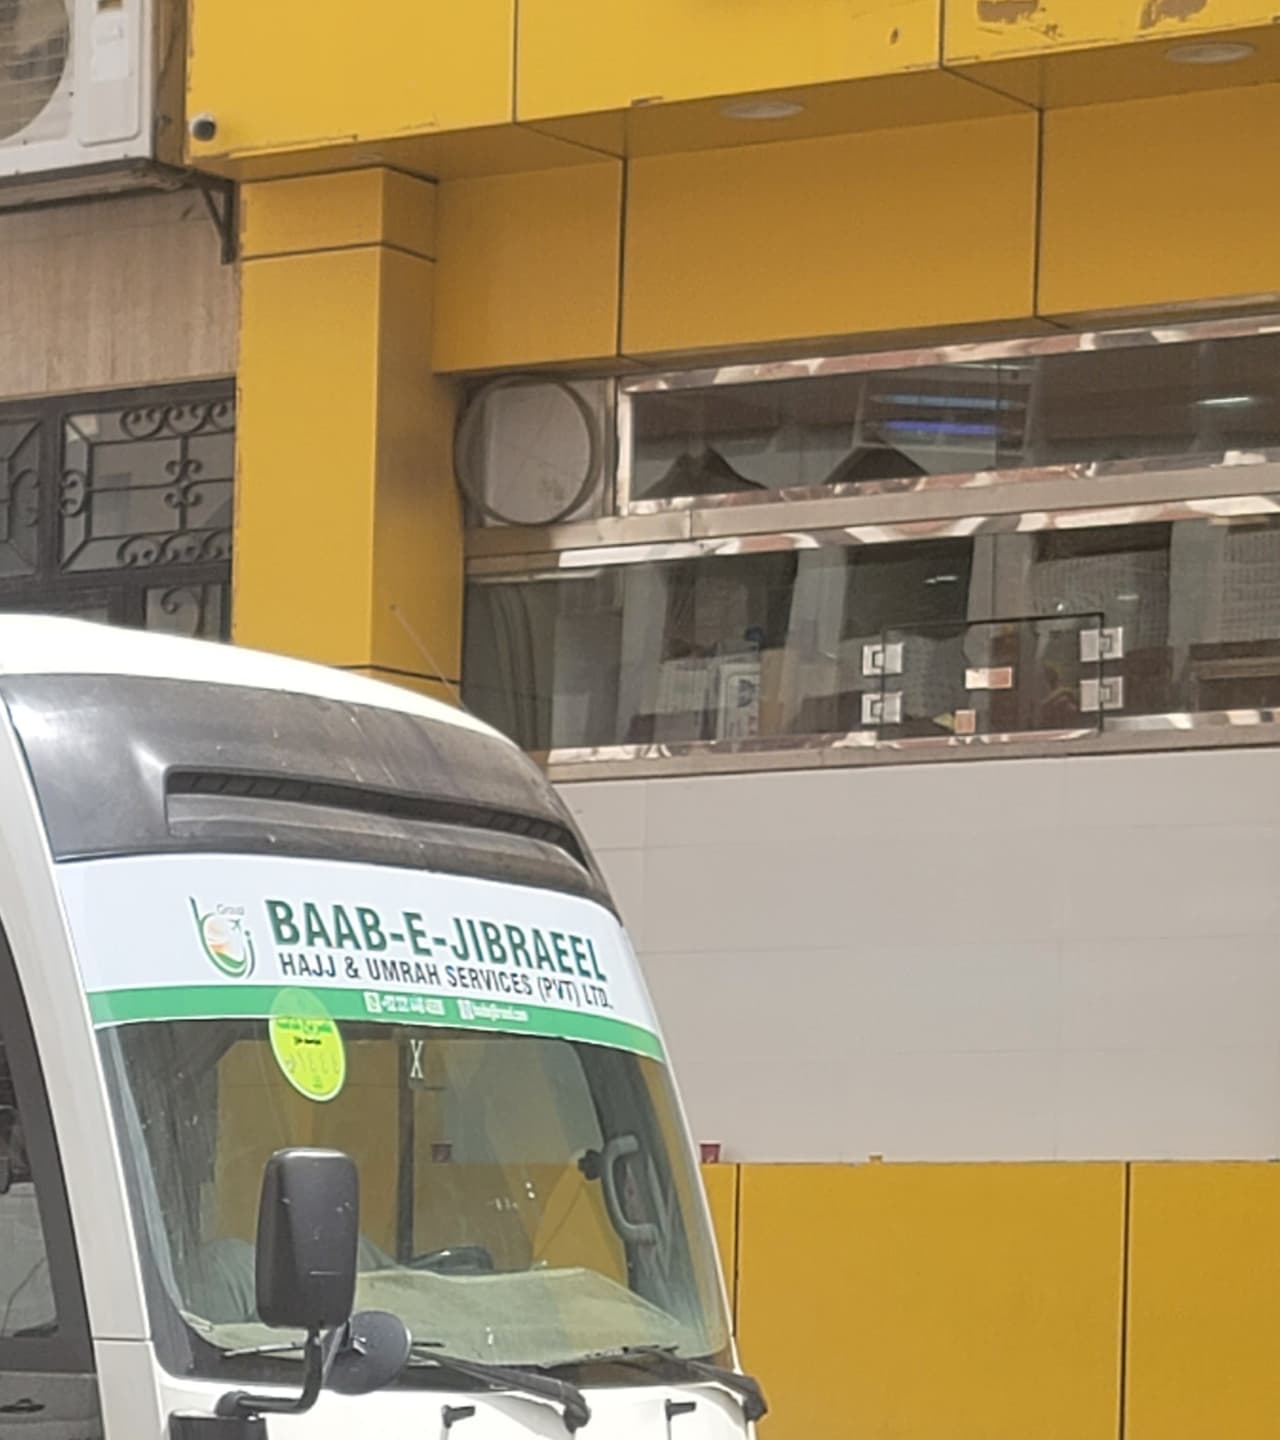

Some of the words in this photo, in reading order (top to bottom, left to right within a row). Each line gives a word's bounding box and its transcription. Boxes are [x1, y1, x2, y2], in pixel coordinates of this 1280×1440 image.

[265, 899, 607, 982] BAAB-E-JIBRAEEL
[278, 953, 337, 978] HAJJ
[345, 955, 359, 979] &
[365, 957, 441, 986] UMRAH
[445, 964, 533, 995] SERVICES
[536, 976, 582, 1007] (PVT)
[582, 984, 614, 1009] LTD.
